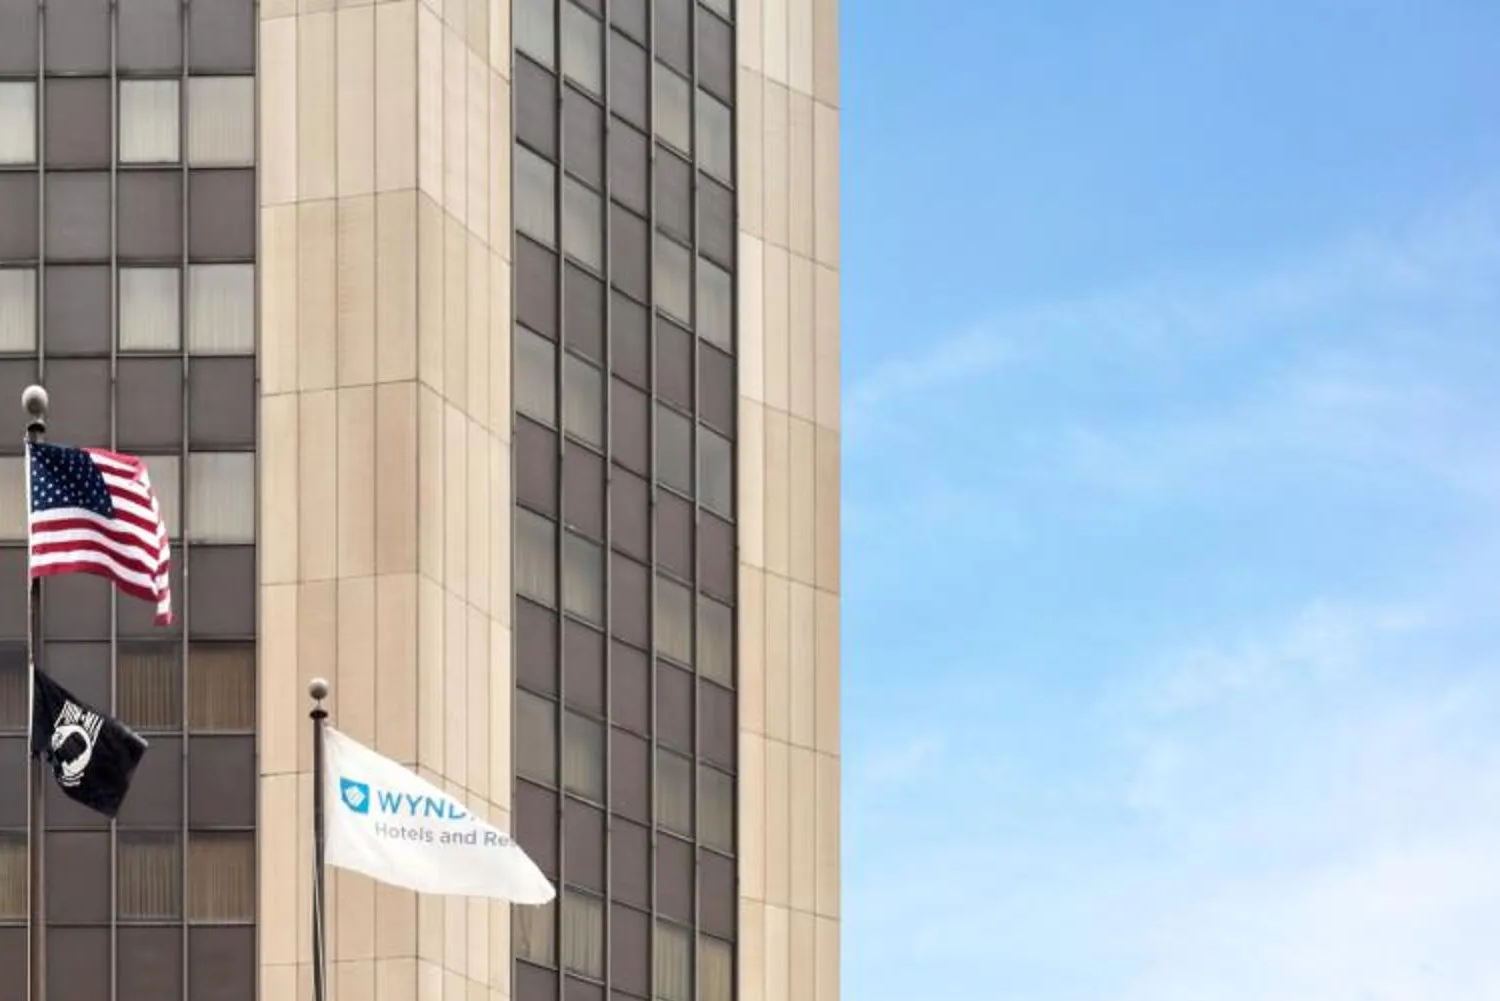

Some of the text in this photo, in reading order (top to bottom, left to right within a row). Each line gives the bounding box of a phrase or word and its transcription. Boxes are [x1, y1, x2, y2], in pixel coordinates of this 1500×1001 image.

[377, 790, 474, 821] WYND
[375, 822, 433, 843] Hotels
[439, 830, 477, 845] and
